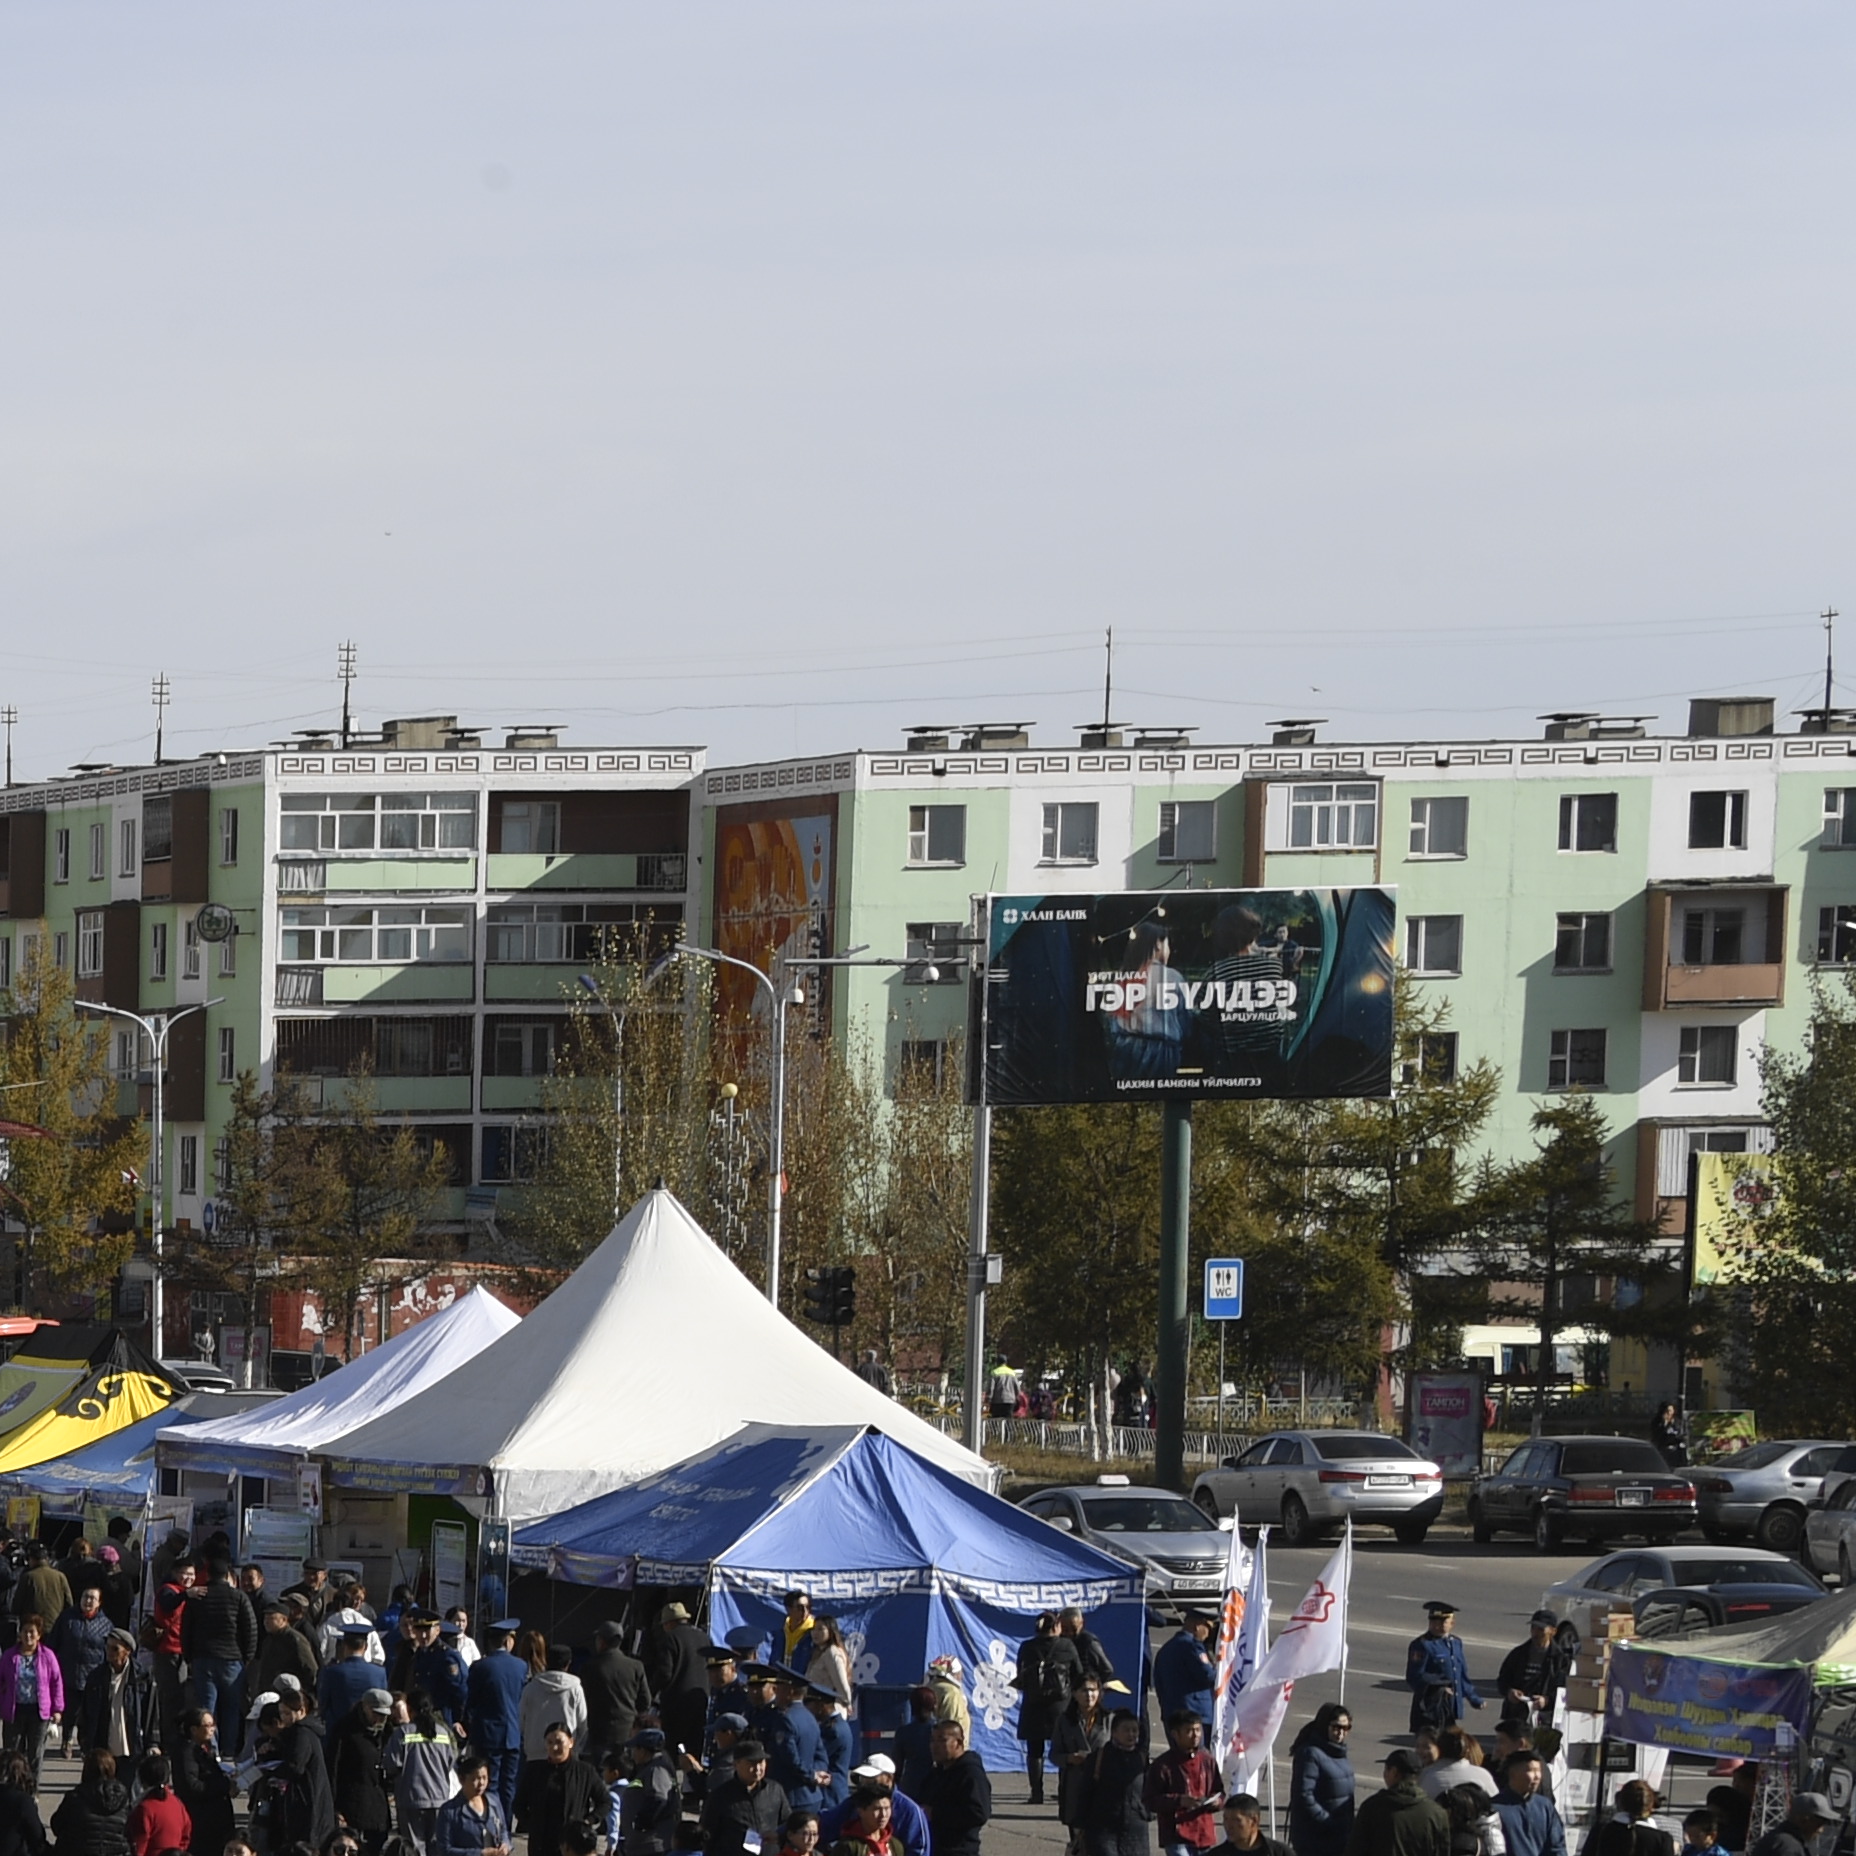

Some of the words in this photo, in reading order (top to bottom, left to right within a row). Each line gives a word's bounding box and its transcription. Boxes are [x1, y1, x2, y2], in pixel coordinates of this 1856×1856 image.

[1056, 909, 1087, 920] БАНК
[1086, 984, 1147, 1012] ГЭР
[1156, 980, 1298, 1013] БҮЛДЭЭ
[1215, 1288, 1232, 1297] WC
